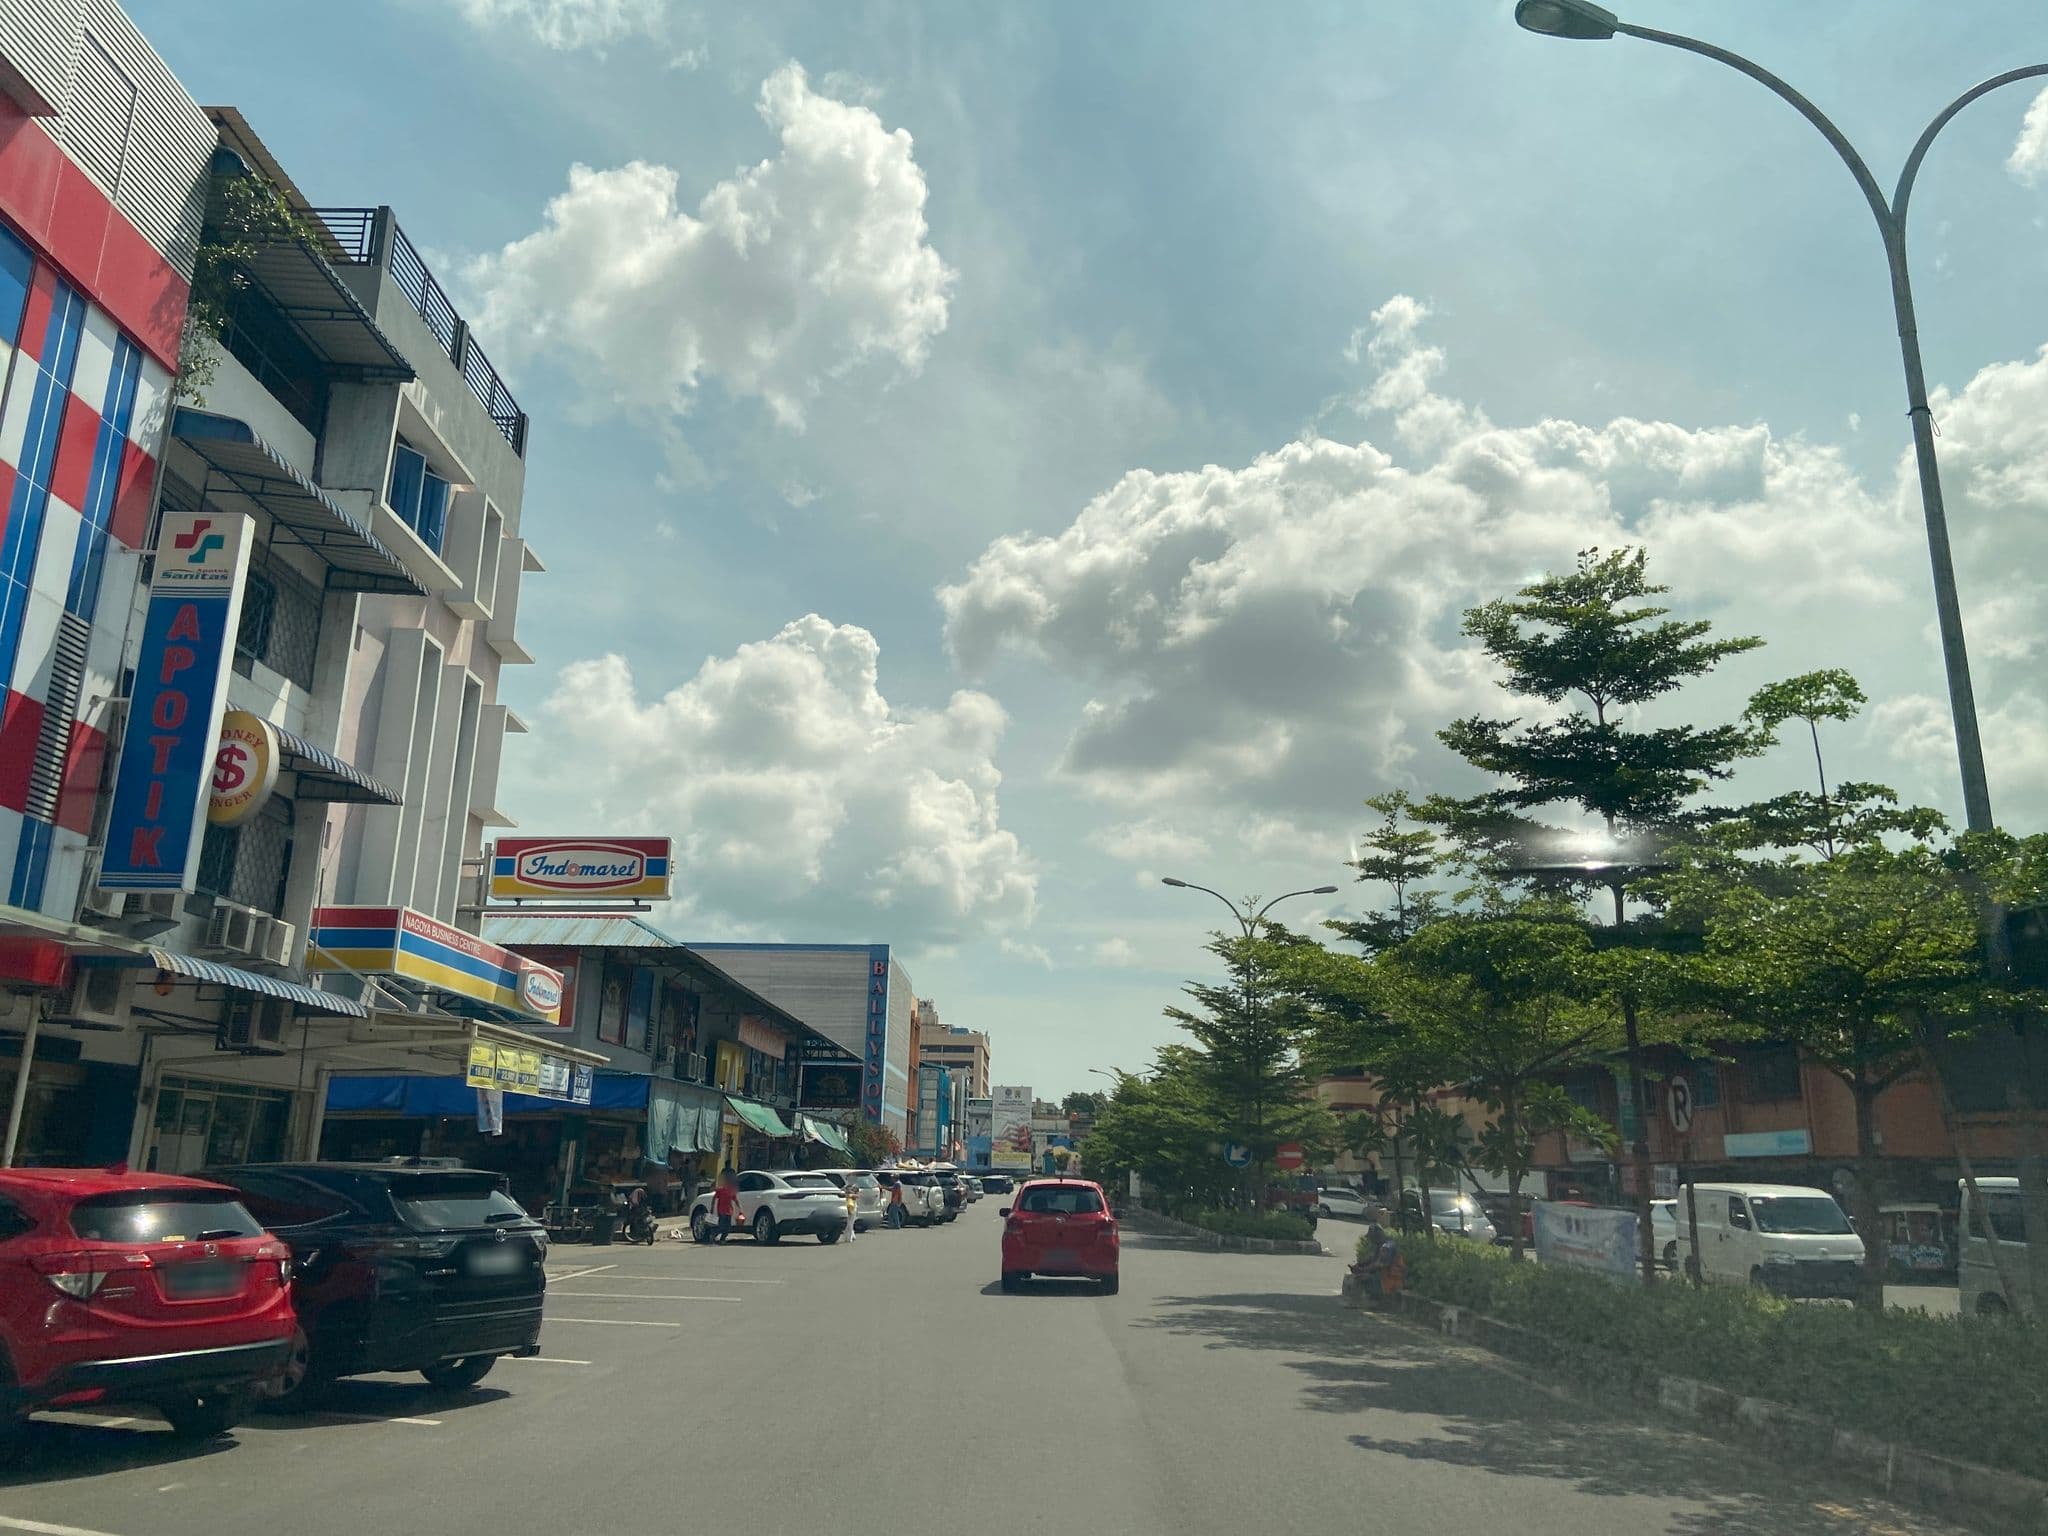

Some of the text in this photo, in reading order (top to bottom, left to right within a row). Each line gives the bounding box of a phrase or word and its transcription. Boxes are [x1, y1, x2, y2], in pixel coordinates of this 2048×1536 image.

[160, 571, 229, 580] Sanitas
[129, 603, 202, 868] APOTIK
[221, 729, 264, 748] ONEY
[525, 855, 637, 877] Indomaret
[405, 915, 481, 953] NAGOYA BUSINESS CENTRE
